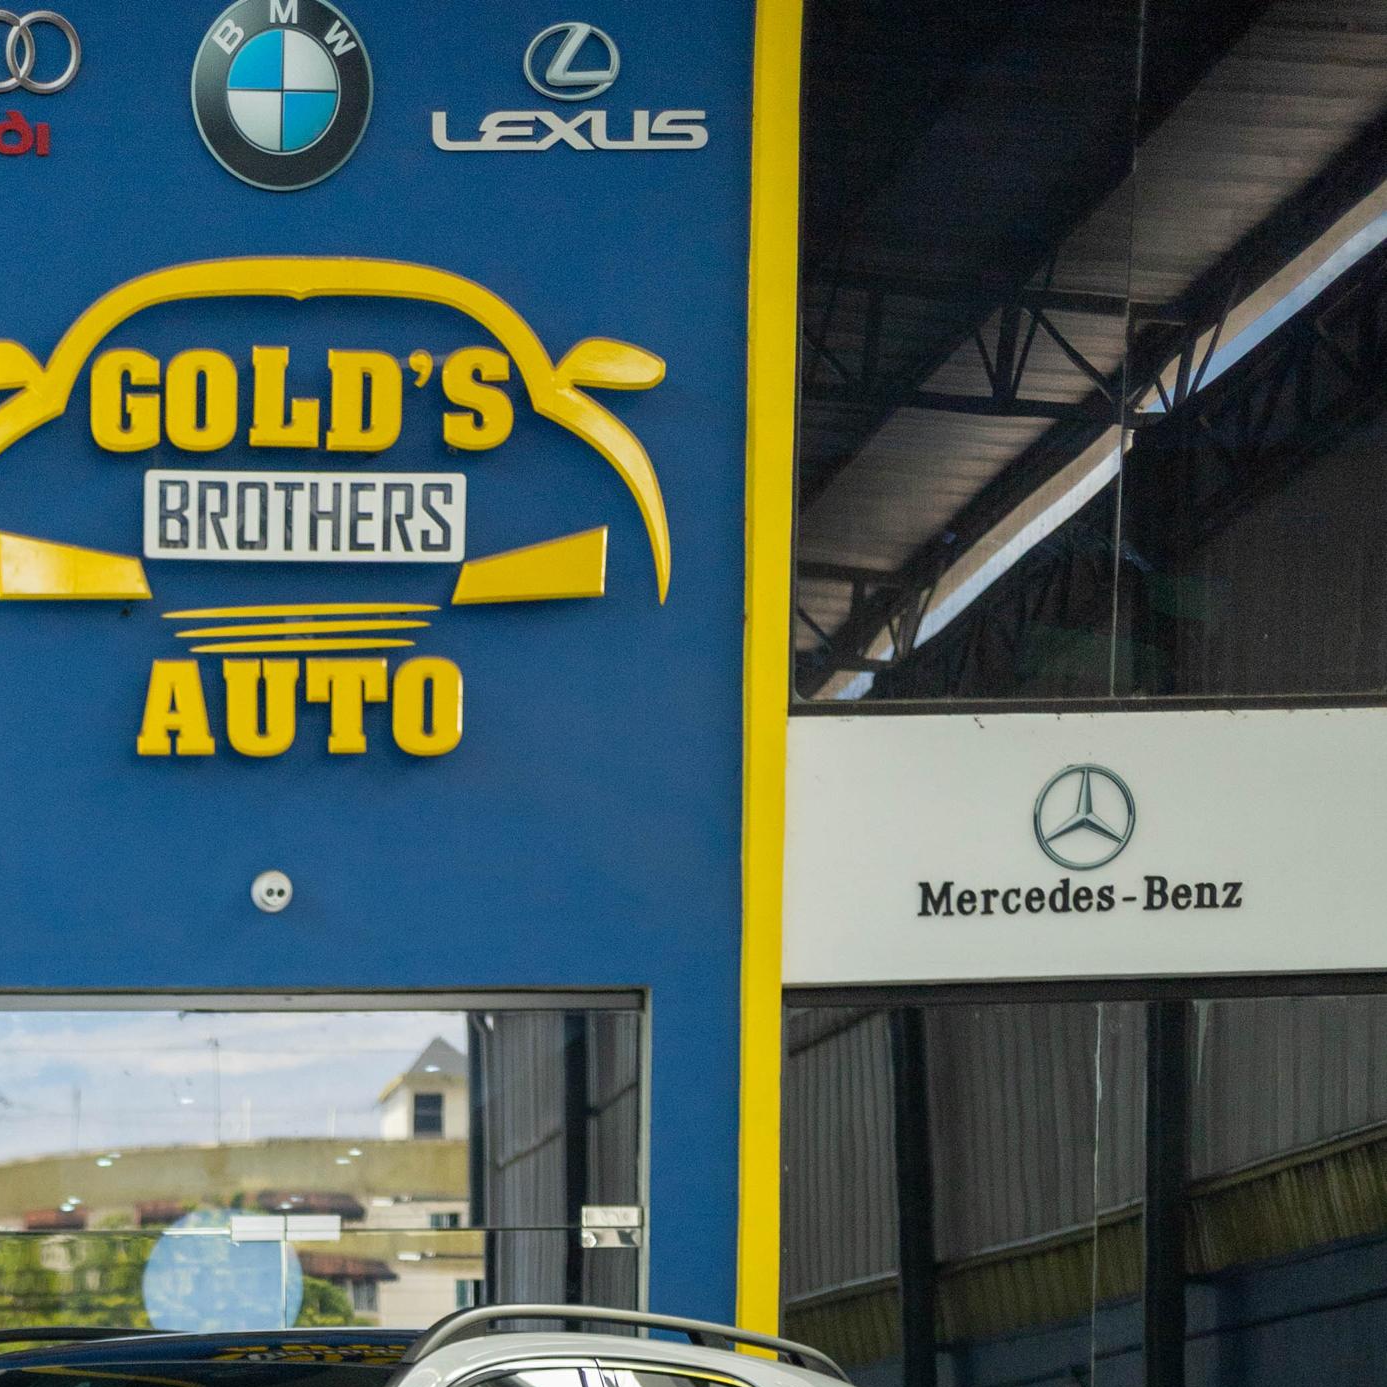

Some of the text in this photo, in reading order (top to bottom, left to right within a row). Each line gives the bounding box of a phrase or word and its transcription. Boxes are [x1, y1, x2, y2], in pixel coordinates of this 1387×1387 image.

[211, 0, 357, 57] BMW
[432, 110, 709, 152] LEXUS
[90, 345, 514, 453] GOLD'S
[158, 479, 452, 552] BROTHERS
[137, 656, 464, 757] AUTO
[917, 876, 1244, 917] Mercedes-Benz
